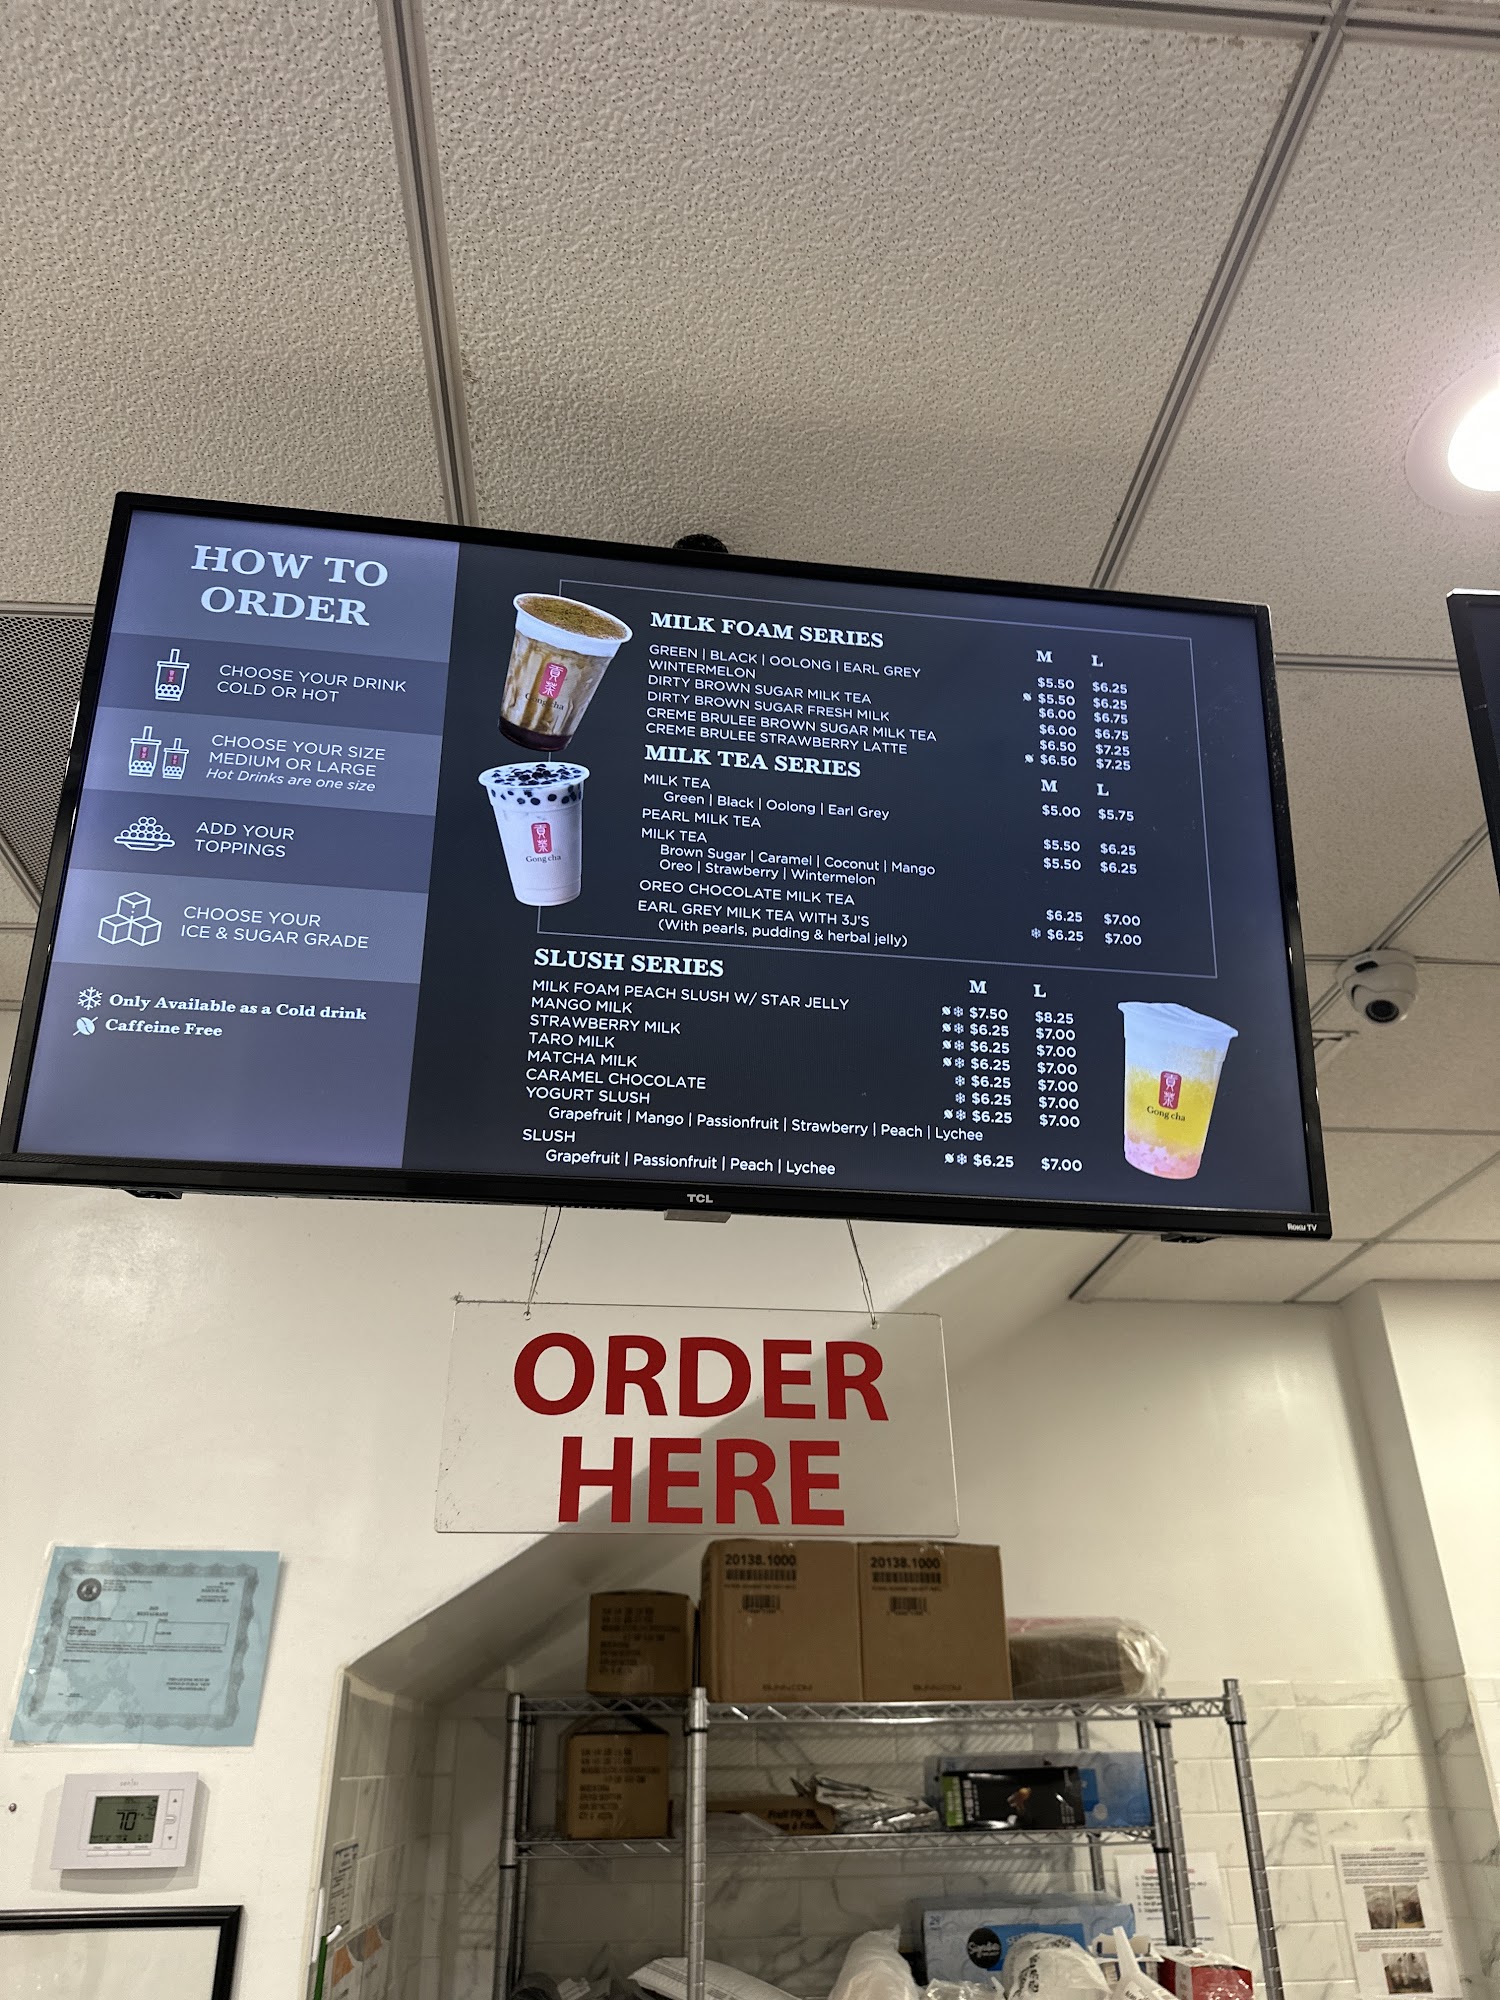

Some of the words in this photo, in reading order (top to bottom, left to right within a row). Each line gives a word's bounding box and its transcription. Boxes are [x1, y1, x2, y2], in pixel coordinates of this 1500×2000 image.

[190, 544, 313, 579] HOW
[323, 556, 388, 587] TO
[200, 586, 370, 626] ORDER
[649, 611, 716, 633] MILK
[720, 618, 794, 640] FOAM
[799, 625, 883, 648] SERIES
[649, 644, 697, 658] GREEN
[710, 649, 757, 664] BLACK
[769, 655, 831, 671] OOLONG
[843, 661, 879, 675] EARL
[883, 665, 921, 678] GREY
[1035, 649, 1053, 663] M
[1091, 654, 1103, 667] L
[219, 664, 293, 682] CHOOSE
[298, 671, 348, 687] YOUR
[352, 676, 406, 692] DRINK
[648, 659, 755, 679] WINTERMELON
[216, 680, 266, 695] COLD
[271, 685, 297, 699] OR
[301, 687, 339, 702] HOT
[647, 674, 690, 688] DIRTY
[694, 678, 750, 693] BROWN
[754, 683, 803, 698] SUGAR
[807, 688, 840, 702] MILK
[843, 691, 871, 704] TEA
[1037, 676, 1074, 690] $5.50
[1092, 680, 1127, 694] $6.25
[1037, 692, 1075, 706] $5.50
[1092, 696, 1127, 710] $6.25
[646, 706, 696, 721] CREME
[700, 711, 756, 727] BRULEE
[760, 716, 815, 732] BROWN
[819, 721, 868, 736] SUGAR
[872, 726, 905, 739] MILK
[908, 728, 937, 741] TEA
[211, 734, 287, 752] CHOOSE
[292, 740, 343, 757] YOUR
[347, 745, 386, 761] SIZE
[1039, 739, 1076, 752] $6.50
[1095, 743, 1130, 756] $7.25
[208, 751, 280, 768] MEDIUM
[285, 757, 311, 771] OR
[316, 760, 377, 777] LARGE
[644, 744, 712, 765] MILK
[717, 750, 768, 770] TEA
[773, 755, 861, 777] SERIES
[205, 767, 235, 780] Hot
[236, 770, 284, 784] Drinks
[287, 776, 312, 786] are
[315, 778, 343, 789] one
[346, 779, 375, 792] size
[1040, 778, 1058, 793] M
[1096, 783, 1109, 796] L
[663, 790, 704, 805] Green
[717, 795, 754, 808] Black
[766, 799, 816, 815] Oolong
[828, 803, 853, 816] Earl
[857, 806, 889, 821] Grey
[1041, 803, 1081, 817] $5.00
[1098, 808, 1134, 821] $5.75
[642, 807, 690, 822] PEARL
[694, 812, 728, 825] MILK
[732, 814, 761, 828] TEA
[195, 821, 237, 836] ADD
[242, 824, 294, 840] YOUR
[194, 838, 286, 857] TOPPINGS
[525, 855, 548, 864] Gong
[547, 854, 562, 862] cha
[660, 843, 703, 858] Brown
[707, 847, 746, 862] Sugar
[758, 851, 812, 866] Caramel
[824, 856, 879, 871] Coconut
[891, 861, 935, 876] Mango
[1043, 856, 1081, 870] $5.50
[1099, 861, 1137, 874] $6.25
[659, 858, 693, 872] Oreo
[705, 861, 779, 880] Strawberry
[790, 868, 875, 885] Wintermelon
[183, 905, 263, 923] CHOOSE
[268, 911, 321, 927] YOUR
[638, 899, 677, 913] EARL
[681, 903, 722, 916] GREY
[726, 905, 761, 919] MILK
[765, 908, 794, 922] TEA
[798, 911, 837, 924] WITH
[841, 914, 869, 927] 3J'S
[180, 924, 211, 939] ICE
[215, 926, 228, 940] &
[232, 927, 298, 944] SUGAR
[303, 932, 369, 949] GRADE
[658, 918, 698, 931] (With
[702, 922, 747, 936] pearls,
[752, 925, 809, 941] pudding
[813, 928, 823, 940] &
[828, 929, 870, 943] herbal
[873, 932, 907, 947] jelly)
[1046, 928, 1084, 942] $6.25
[1104, 932, 1142, 945] $7.00
[534, 947, 625, 971] SLUSH
[630, 954, 724, 977] SERIES
[532, 979, 569, 993] MILK
[573, 981, 619, 996] FOAM
[624, 984, 676, 999] PEACH
[680, 988, 729, 1003] SLUSH
[733, 991, 757, 1005] W/
[760, 993, 800, 1007] STAR
[804, 996, 849, 1010] JELLY
[968, 979, 987, 994] M
[1033, 983, 1046, 998] L
[108, 993, 151, 1011] Only
[153, 996, 236, 1013] Available
[239, 1004, 258, 1014] as
[260, 1005, 272, 1015] a
[275, 1003, 315, 1017] Cold
[319, 1005, 367, 1020] drink
[531, 996, 591, 1011] MANGO
[596, 1000, 632, 1014] MILK
[969, 1006, 1008, 1020] $7.50
[529, 1013, 640, 1031] STRAWBERRY
[644, 1020, 680, 1034] MILK
[1035, 1010, 1074, 1024] $8.25
[104, 1018, 180, 1034] Caffeine
[183, 1022, 222, 1036] Free
[970, 1057, 1010, 1071] $6.25
[1037, 1061, 1077, 1075] $7.00
[525, 1068, 603, 1084] CARAMEL
[608, 1072, 706, 1089] CHOCOLATE
[525, 1085, 594, 1101] YOGURT
[598, 1089, 650, 1104] SLUSH
[1146, 1105, 1170, 1121] Gong
[1170, 1111, 1186, 1122] cha
[548, 1106, 622, 1122] Grapefruit
[635, 1110, 684, 1127] Mango
[697, 1113, 779, 1130] Passionfruit
[791, 1118, 868, 1137] Strawberry
[880, 1123, 922, 1137] Peach
[935, 1126, 983, 1141] Lychee
[973, 1153, 1014, 1168] $6.25
[1040, 1156, 1082, 1172] $7.00
[687, 1193, 713, 1203] TCL
[1306, 1223, 1317, 1231] TV
[514, 1332, 889, 1421] ORDER
[558, 1436, 845, 1526] HERE
[725, 1553, 797, 1566] 20138.1000
[870, 1556, 941, 1569] 20138.1000
[116, 1811, 137, 1831] 70
